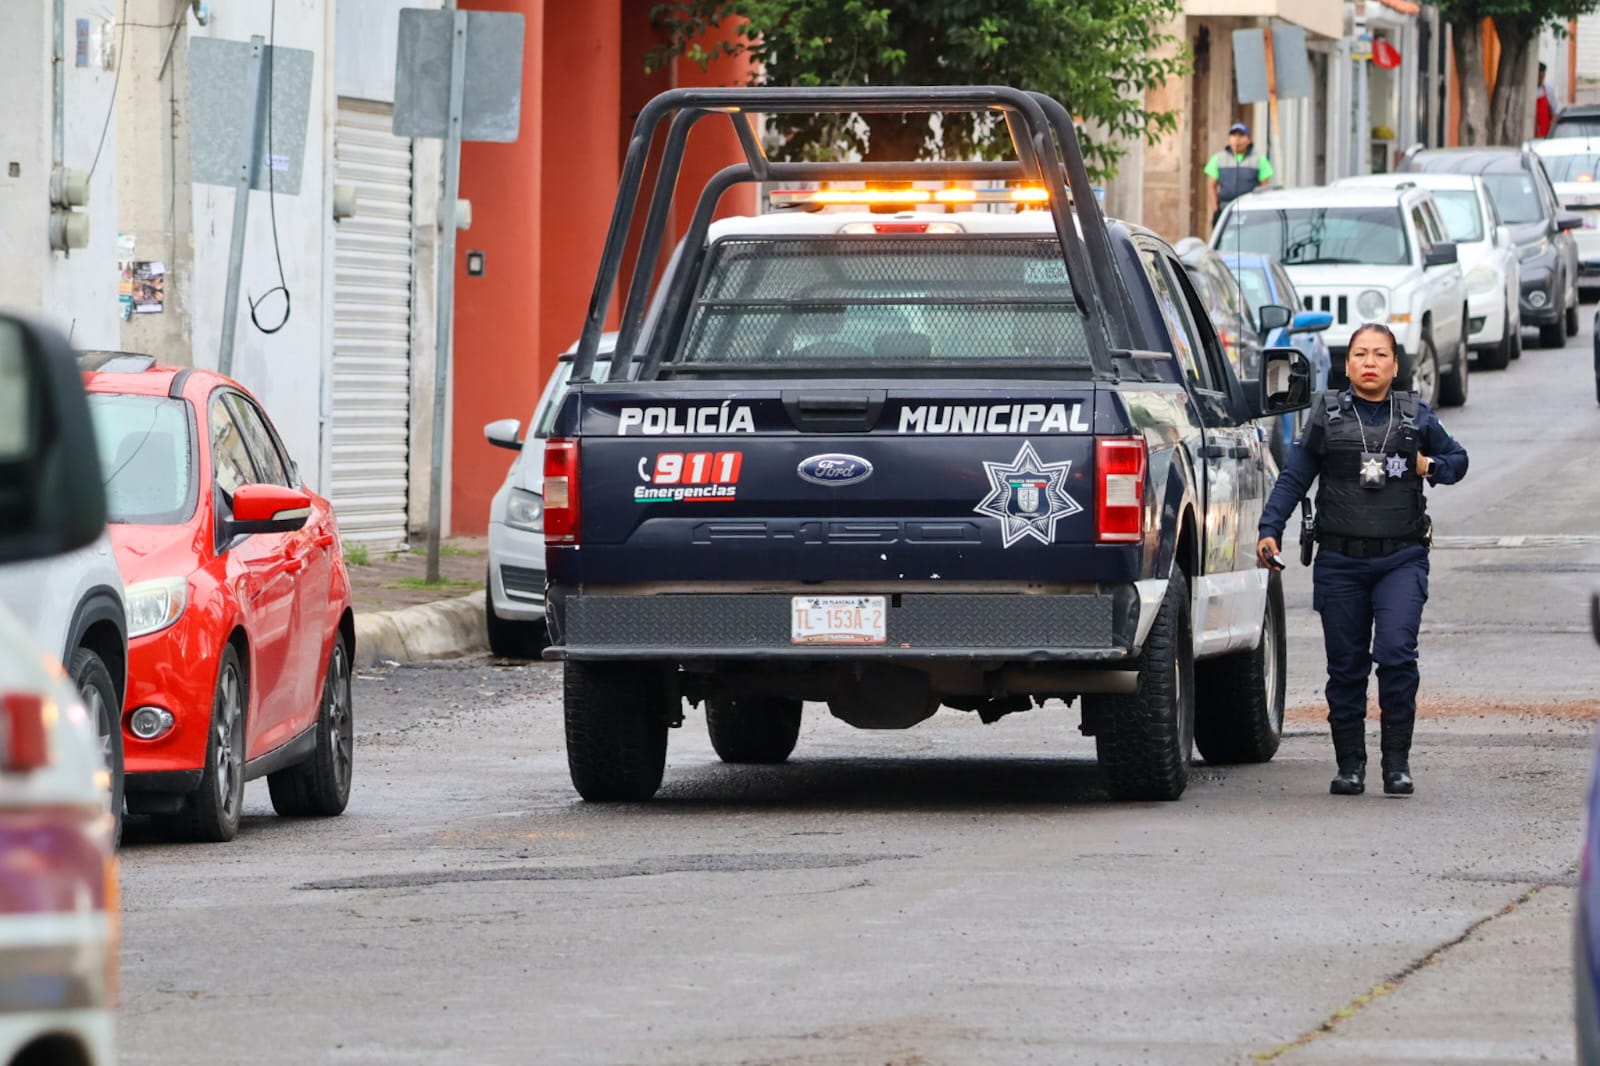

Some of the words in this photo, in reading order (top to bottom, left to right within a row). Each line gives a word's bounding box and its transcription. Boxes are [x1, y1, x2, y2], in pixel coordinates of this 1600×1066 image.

[617, 400, 756, 435] POLICÍA
[898, 403, 1090, 433] MUNICIPAL
[654, 453, 736, 484] 911
[814, 458, 855, 478] Ford
[634, 484, 736, 500] Emergencias
[692, 521, 982, 544] F-150
[795, 608, 883, 630] TL-153A-2
